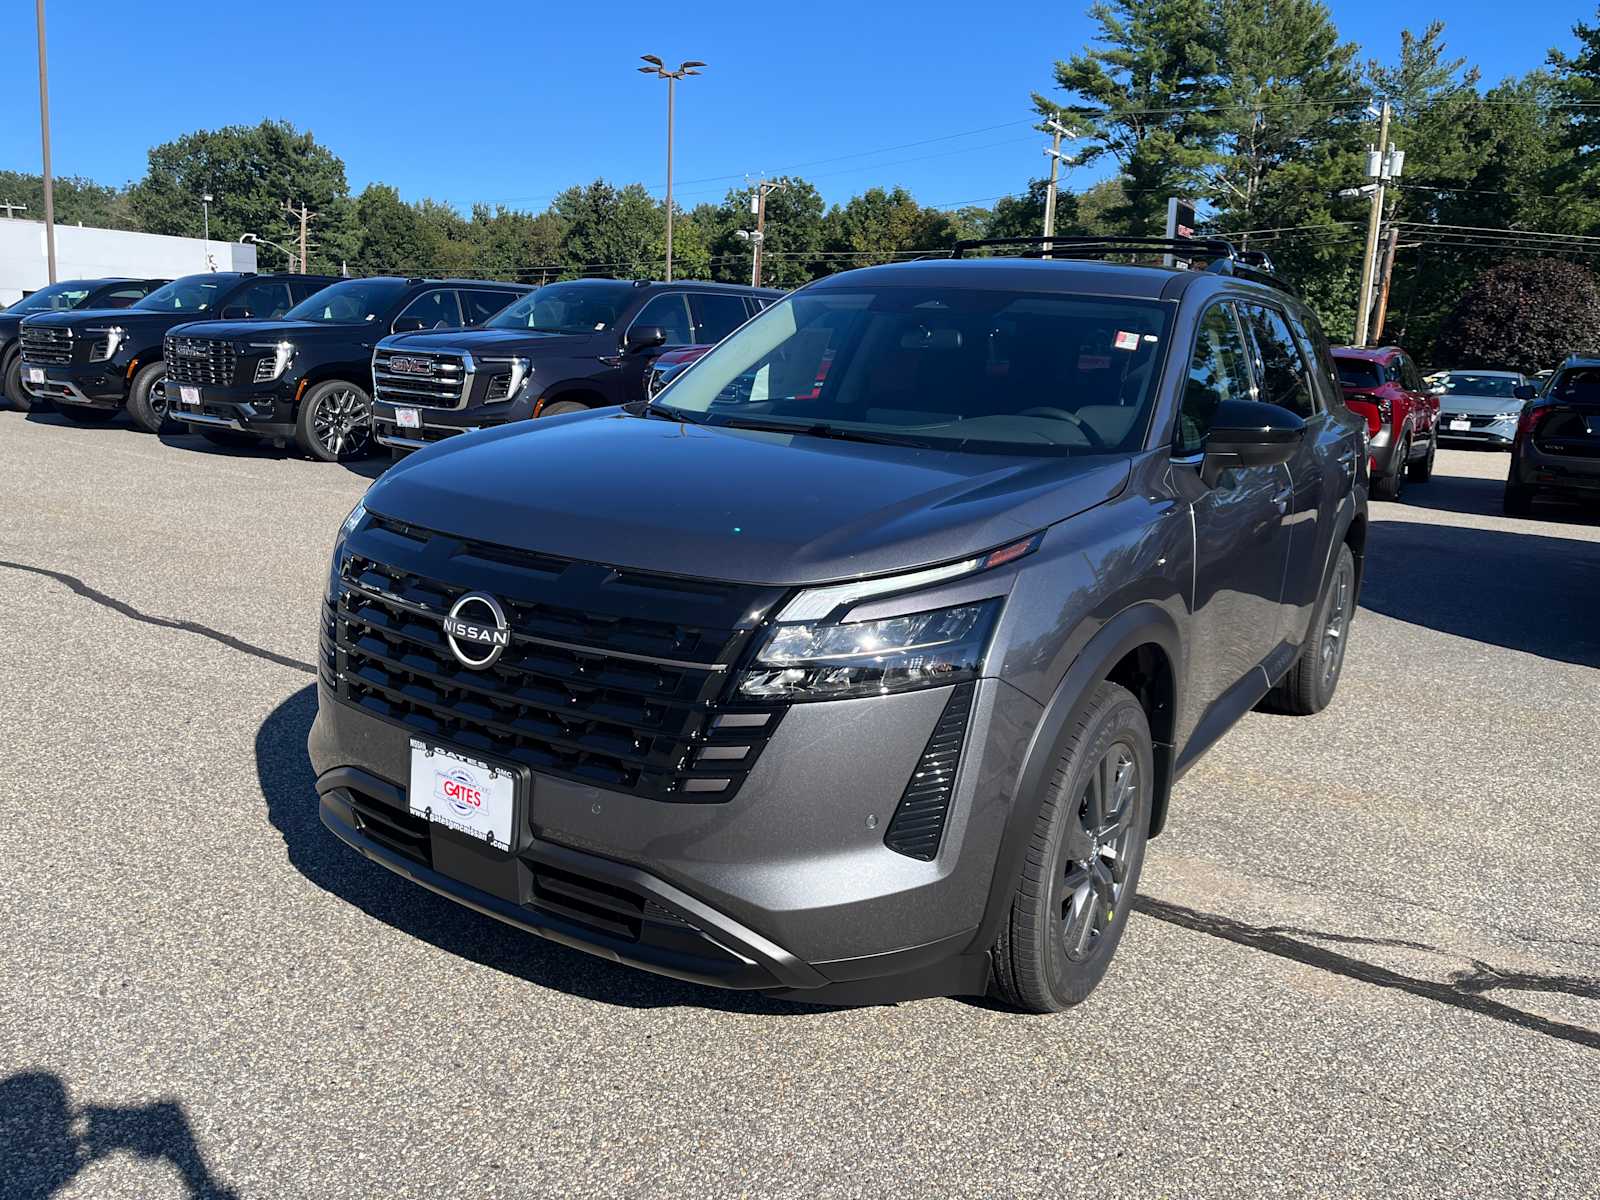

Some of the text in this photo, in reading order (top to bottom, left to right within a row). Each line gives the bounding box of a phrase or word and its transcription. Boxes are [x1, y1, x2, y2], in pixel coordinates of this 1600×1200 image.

[392, 359, 429, 373] GMC
[443, 618, 507, 644] NISSAN
[434, 747, 489, 769] GATES
[494, 767, 513, 779] GMC
[444, 780, 481, 807] GATES
